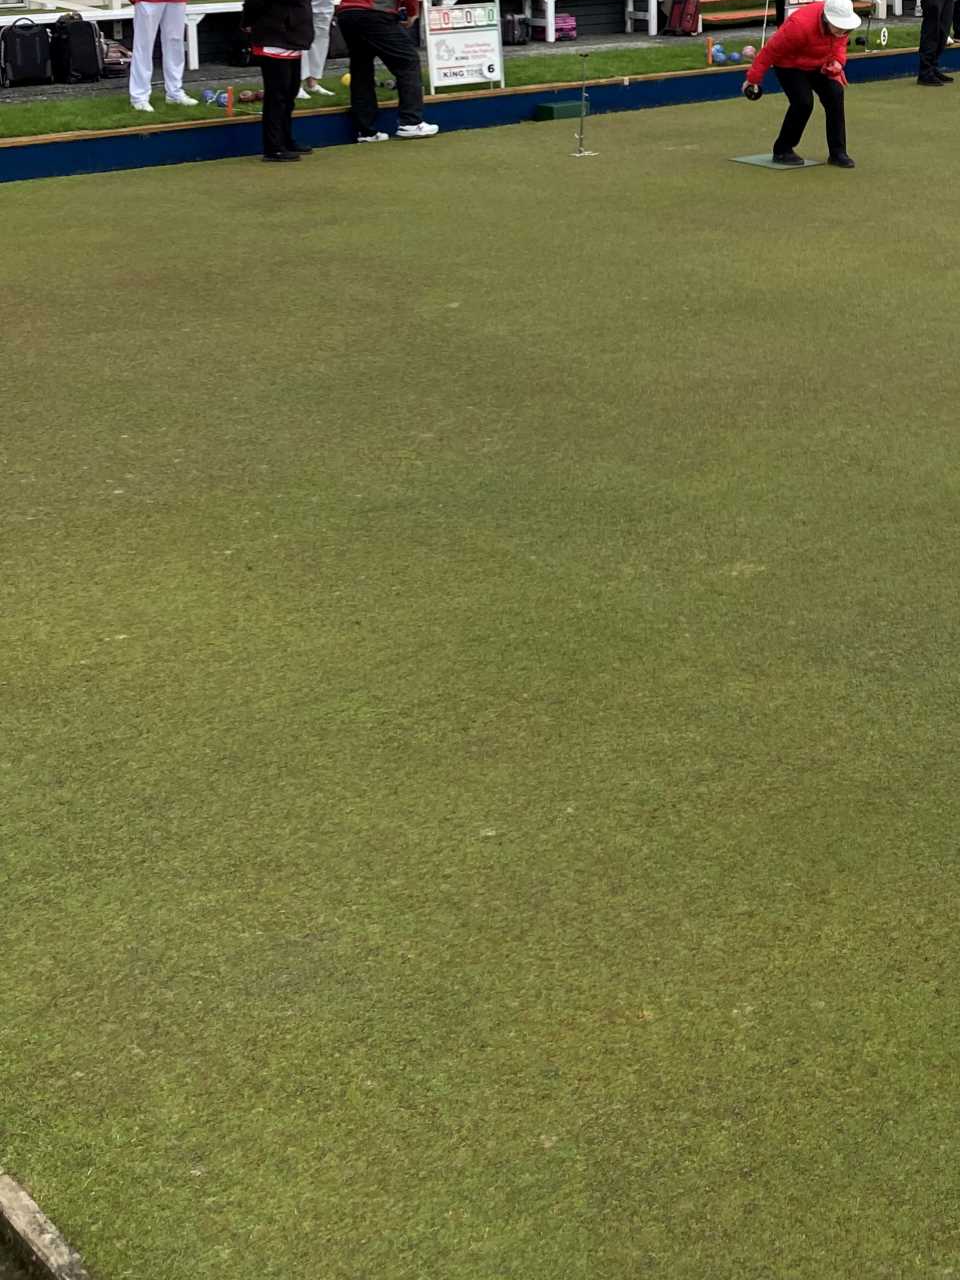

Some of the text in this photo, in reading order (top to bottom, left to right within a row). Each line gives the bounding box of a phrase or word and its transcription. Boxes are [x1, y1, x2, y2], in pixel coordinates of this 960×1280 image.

[443, 11, 449, 25] 0
[465, 10, 472, 23] 0
[488, 8, 494, 22] 0
[443, 69, 464, 78] KING
[487, 64, 495, 73] 6
